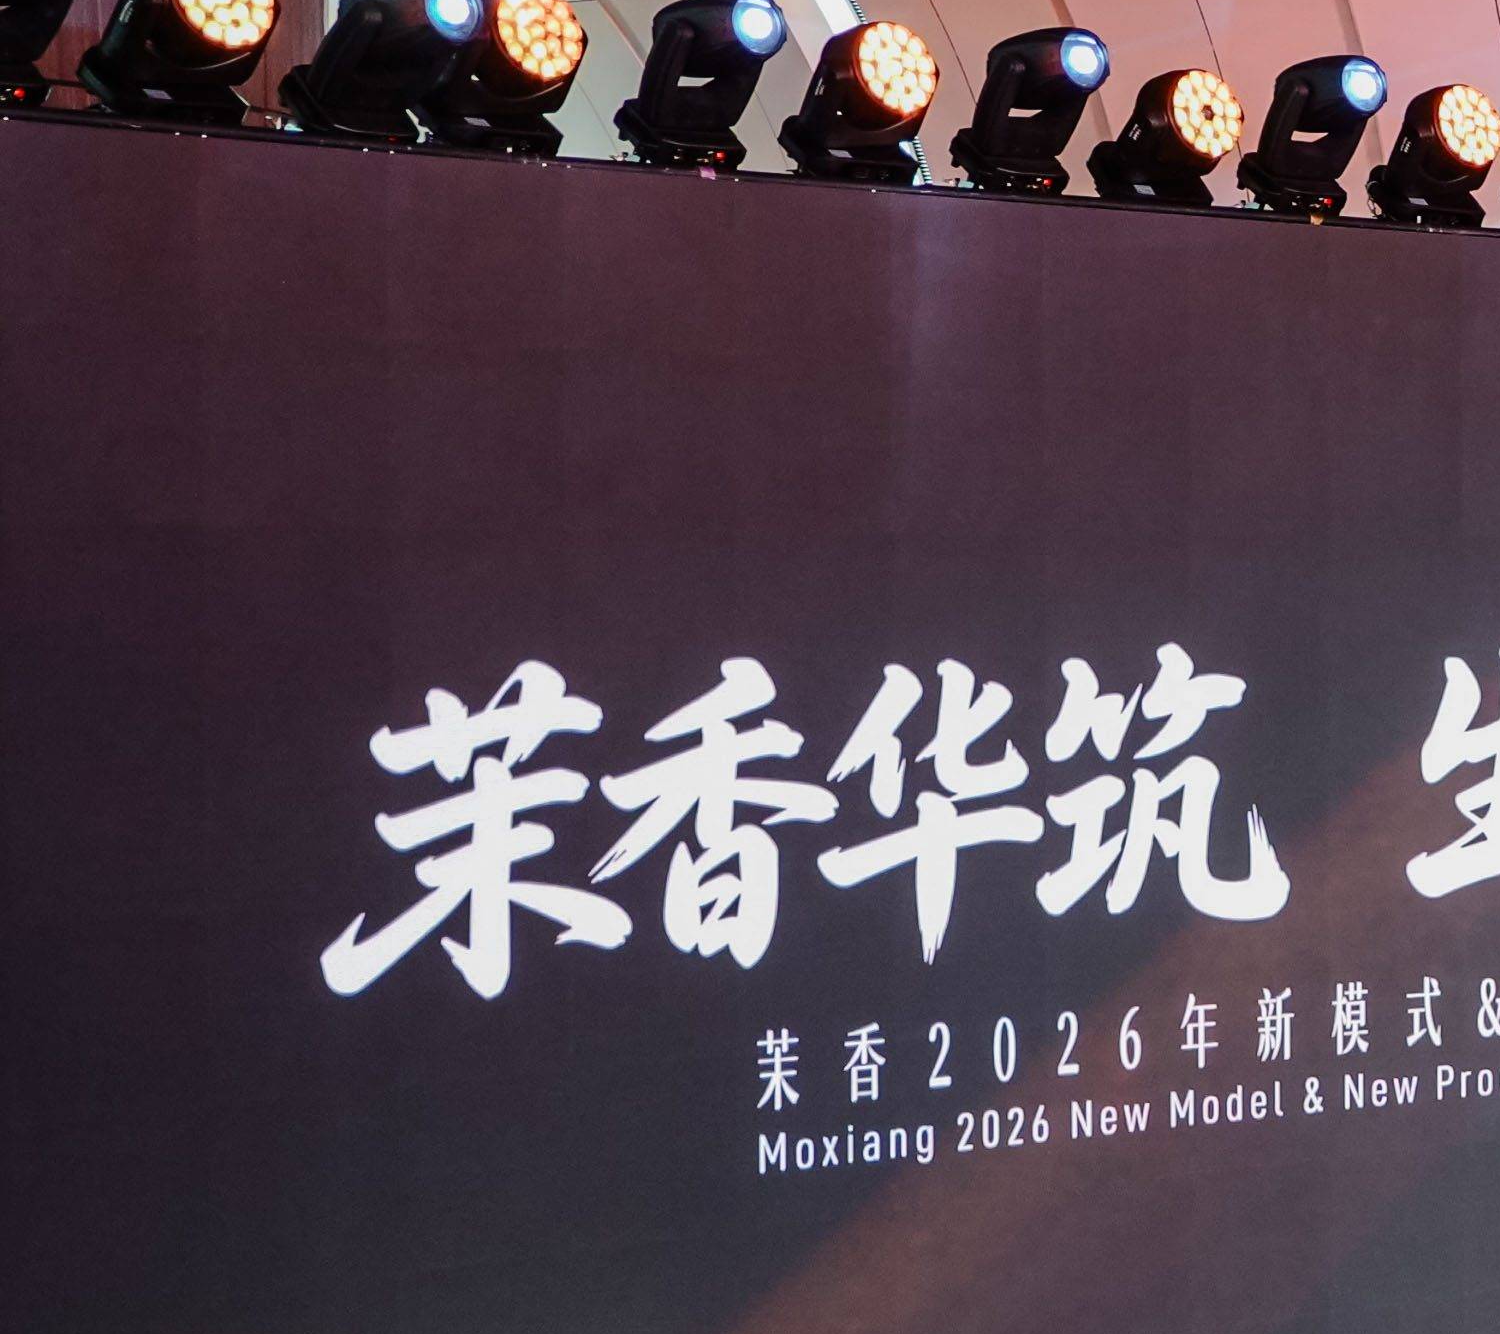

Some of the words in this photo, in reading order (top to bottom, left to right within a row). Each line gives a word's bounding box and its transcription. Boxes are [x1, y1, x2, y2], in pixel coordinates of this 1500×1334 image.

[319, 642, 1291, 1000] 茉香华筑
[757, 1123, 935, 1175] Moxiang
[956, 1103, 1051, 1153] 2026
[1069, 1099, 1152, 1140] New
[1168, 1080, 1284, 1129] Model
[1302, 1077, 1325, 1115] &
[1342, 1071, 1419, 1111] New
